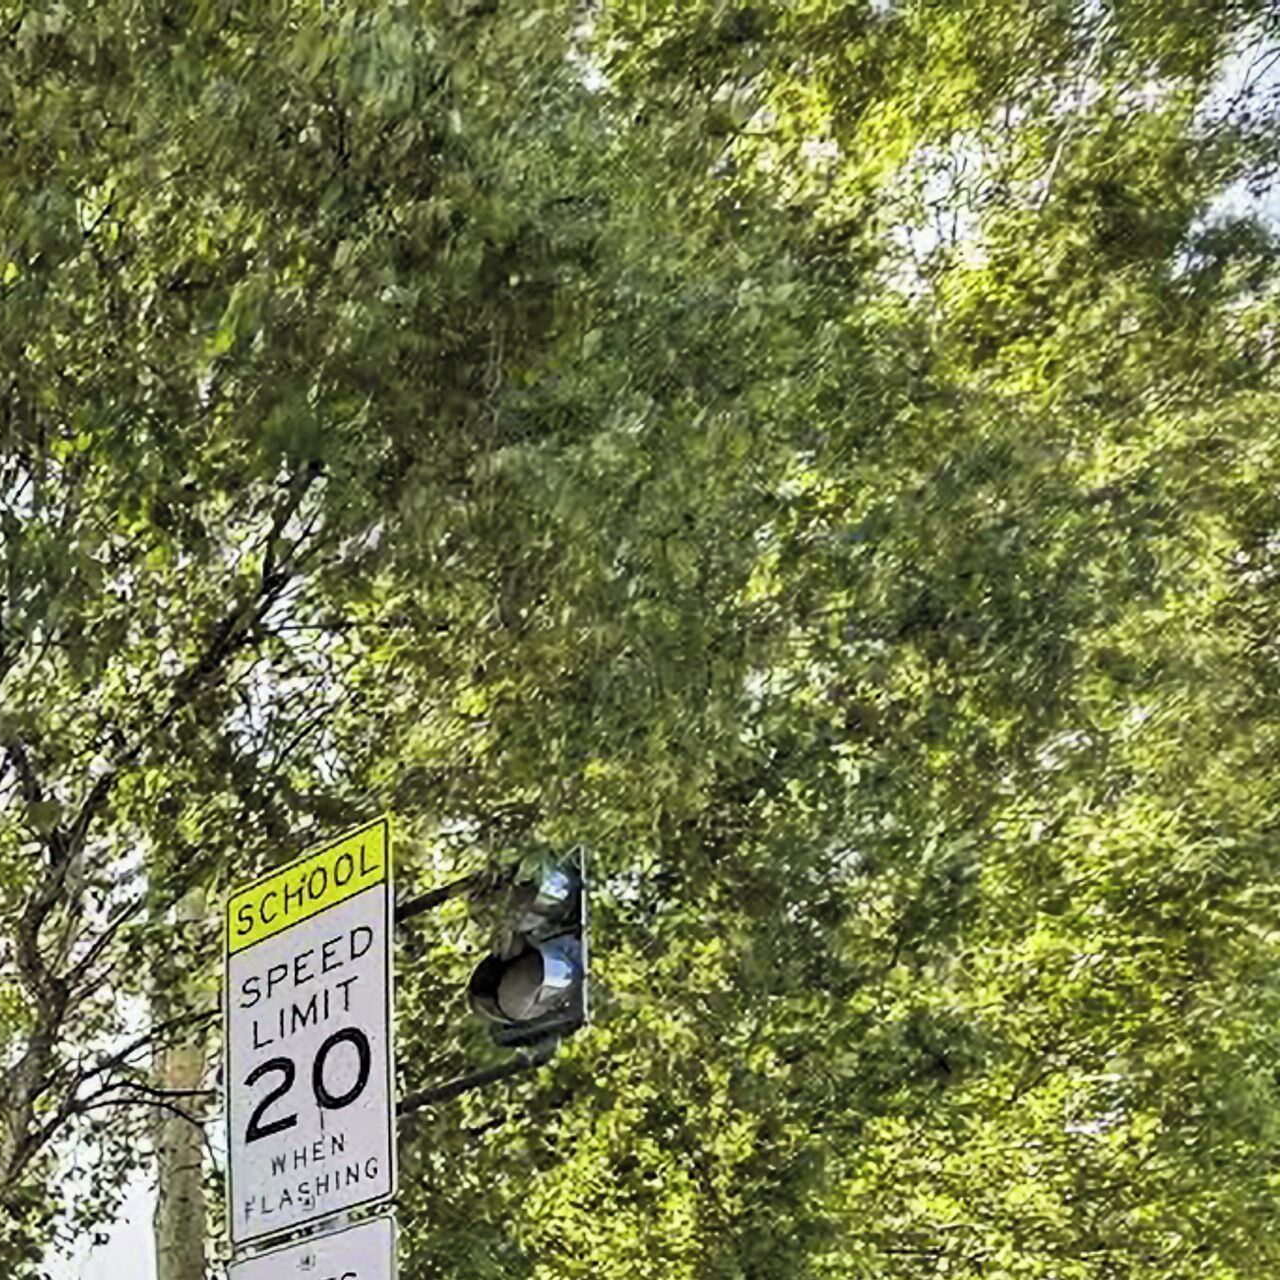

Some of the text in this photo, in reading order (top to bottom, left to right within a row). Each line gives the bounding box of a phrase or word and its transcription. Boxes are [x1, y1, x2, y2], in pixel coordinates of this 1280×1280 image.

[236, 845, 380, 936] SCHOOL
[240, 926, 373, 1008] SPEED
[253, 976, 358, 1050] LIMIT
[244, 1026, 371, 1143] 20
[245, 1157, 379, 1223] FLASHING
[271, 1133, 345, 1177] WHEN
